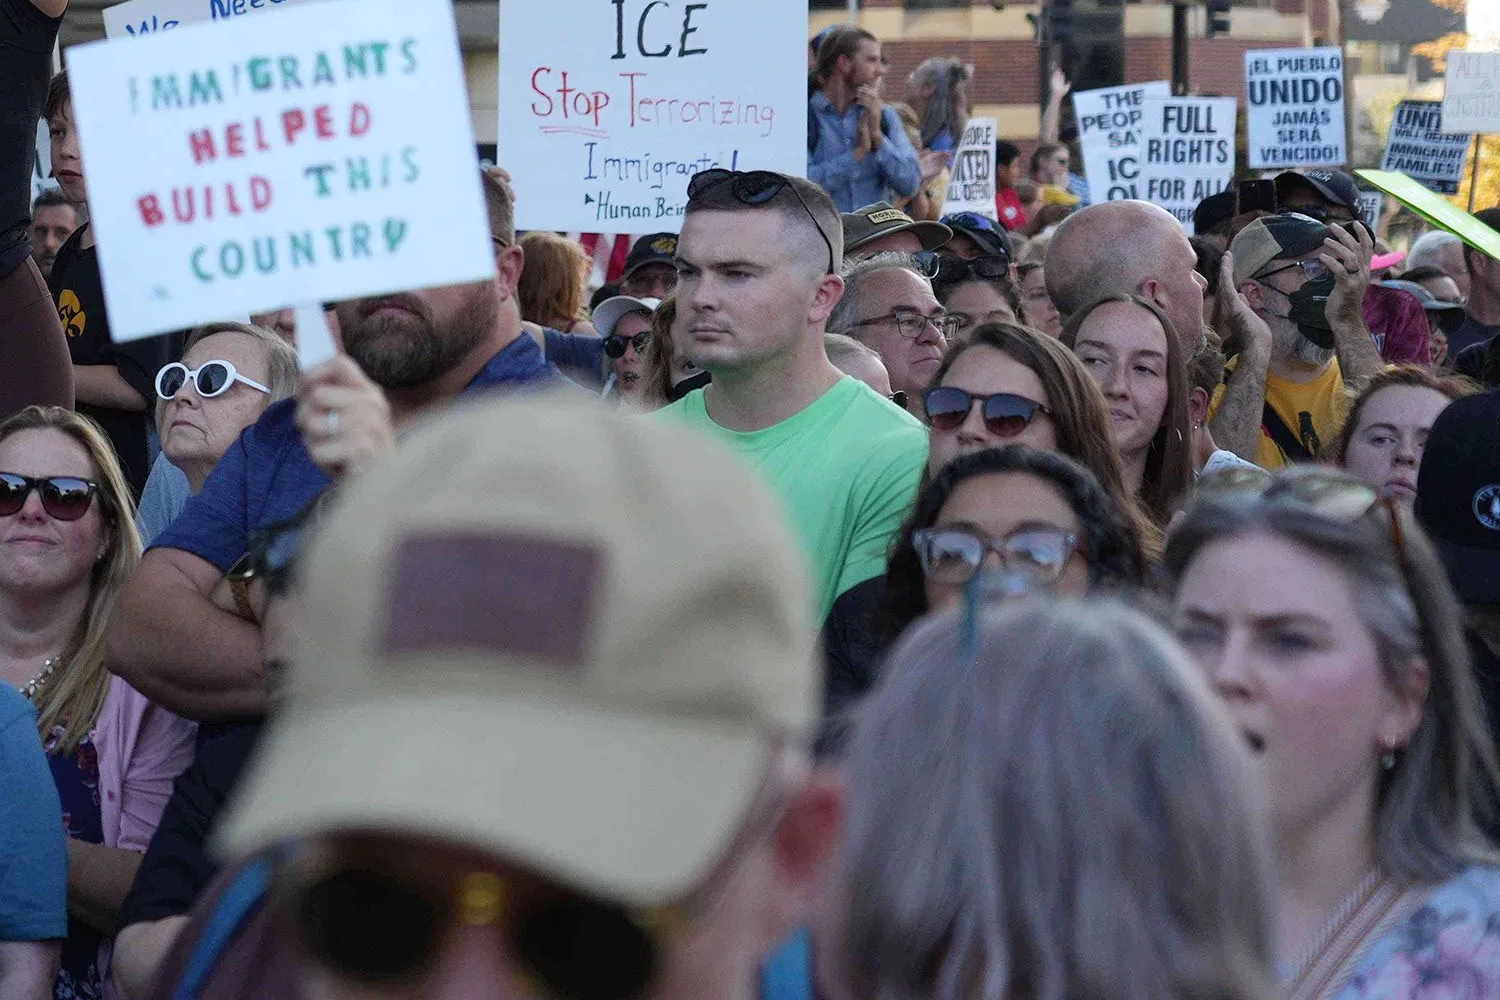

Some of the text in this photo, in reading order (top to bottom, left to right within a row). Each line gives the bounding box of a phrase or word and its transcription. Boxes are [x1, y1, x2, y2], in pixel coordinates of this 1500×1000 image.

[129, 39, 420, 113] IMMIGRANTS
[1278, 57, 1341, 73] PUEBLO
[531, 67, 776, 137] Stop Terrorizing
[1101, 89, 1145, 109] THE
[1249, 77, 1342, 105] UNIDO
[1082, 110, 1142, 133] PEOP
[1163, 106, 1217, 134] FULL
[188, 103, 373, 165] HELPED
[1108, 129, 1142, 147] SA
[1147, 139, 1229, 164] RIGHTS
[1260, 146, 1339, 162] VENCIDO!
[1390, 144, 1462, 159] IMMIGRANT
[1107, 157, 1140, 182] IC
[1386, 158, 1461, 174] FAMILIES!
[137, 147, 421, 229] BUILD THIS
[1148, 178, 1185, 200] FOR
[596, 191, 686, 220] Human Bein
[190, 217, 409, 282] COUNTRY
